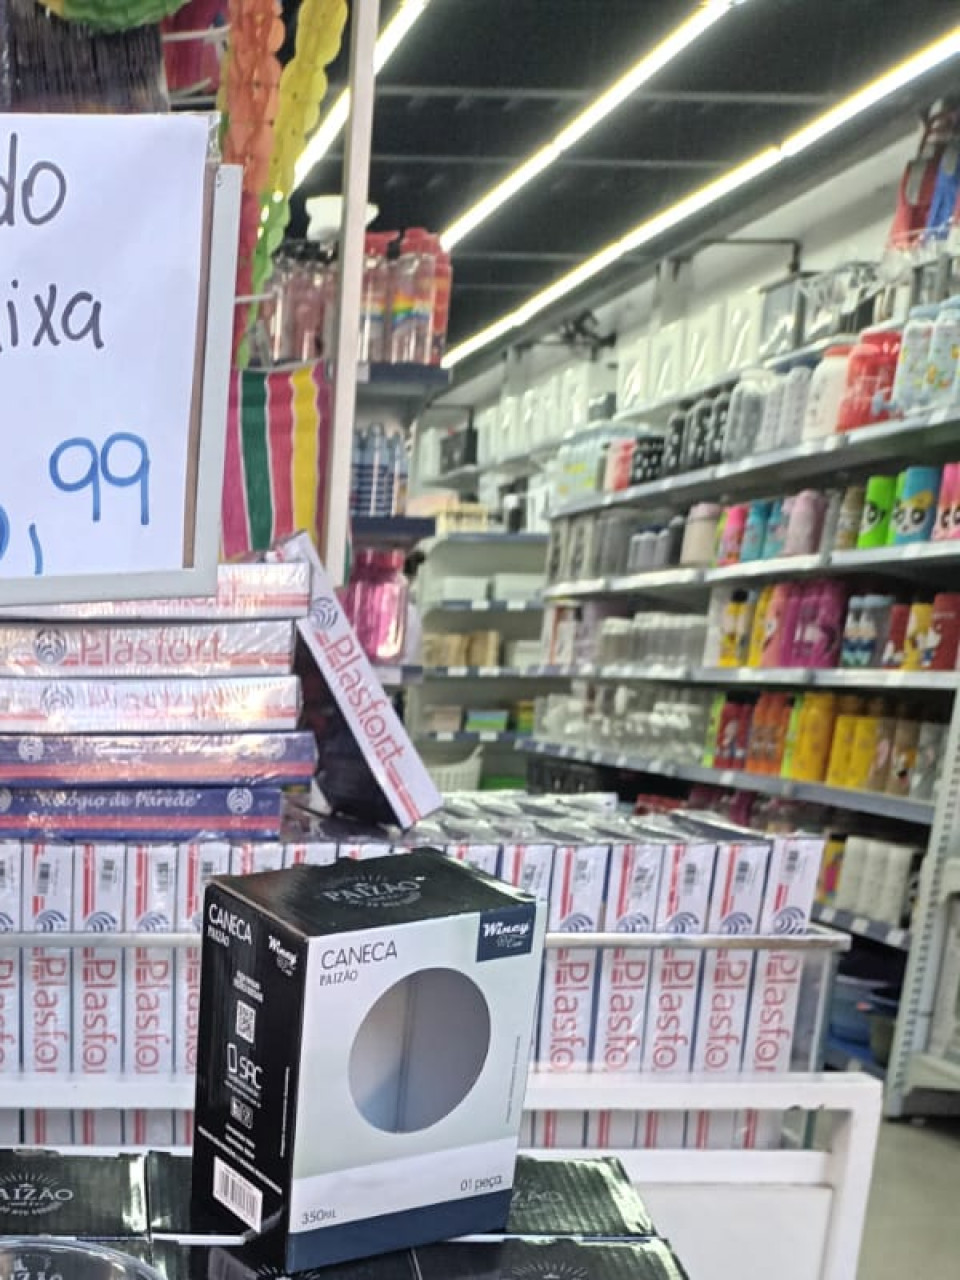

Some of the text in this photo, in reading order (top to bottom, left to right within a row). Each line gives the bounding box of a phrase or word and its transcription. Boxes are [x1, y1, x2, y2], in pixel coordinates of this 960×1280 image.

[81, 627, 221, 665] Plasfort
[325, 634, 405, 765] Plasfort
[209, 903, 252, 945] CANECA
[321, 940, 398, 970] CANECA
[33, 957, 69, 1073] Plasfo
[82, 958, 118, 1074] Plasfo
[135, 958, 171, 1074] Plasfo
[551, 962, 590, 1070] Plasfo
[605, 961, 646, 1070] Plasfo
[653, 961, 696, 1070] Plasfo
[706, 961, 748, 1069] Plasfo
[754, 955, 799, 1072] Plasfo
